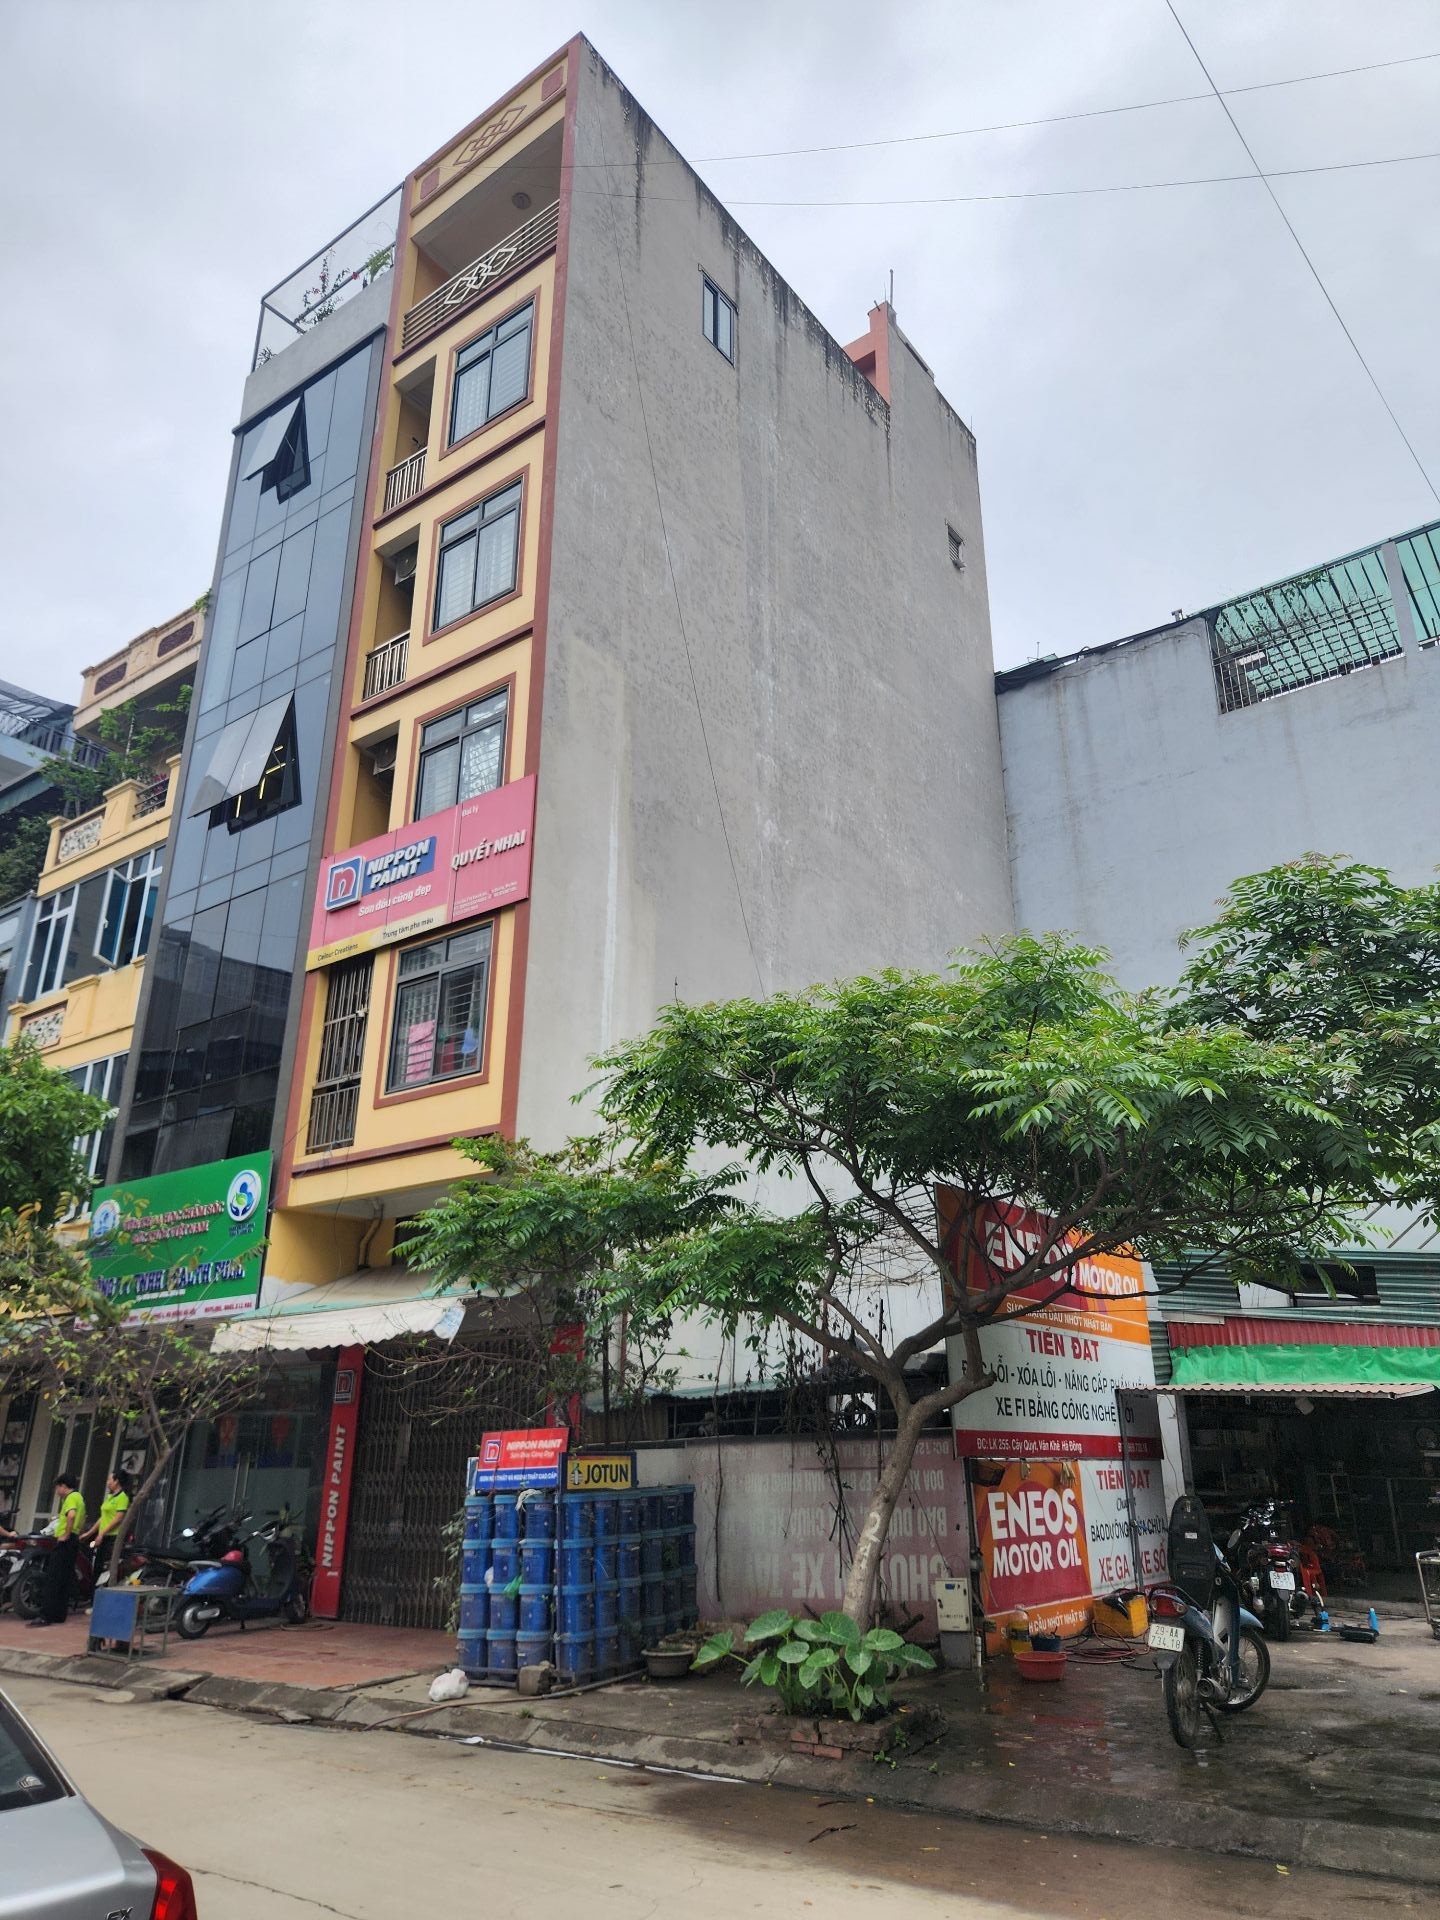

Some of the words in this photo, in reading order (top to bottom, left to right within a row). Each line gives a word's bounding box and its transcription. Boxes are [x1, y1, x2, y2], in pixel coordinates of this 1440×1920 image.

[367, 839, 431, 876] NIPPON
[451, 838, 493, 871] QUYẾT
[494, 829, 526, 855] NHAI
[370, 858, 421, 890] PAINT
[1079, 1261, 1122, 1295] MOTOR
[1070, 1337, 1099, 1363] ĐẠT
[1017, 1362, 1037, 1386] XÓA
[1041, 1361, 1056, 1388] LỖI
[1065, 1369, 1088, 1392] NÂNG
[1092, 1370, 1108, 1394] CẤP
[996, 1397, 1012, 1416] XE
[1015, 1398, 1025, 1417] FI
[1029, 1392, 1058, 1419] BẰNG
[1061, 1398, 1088, 1419] CÔNG
[1091, 1400, 1116, 1427] NGHỆ
[506, 1440, 537, 1451] NIPPON
[538, 1438, 563, 1449] PAINT
[585, 1464, 629, 1484] JOTUN
[322, 1490, 339, 1568] NIPPON
[332, 1424, 346, 1485] PAINT
[988, 1488, 1078, 1540] ENEOS
[1091, 1520, 1105, 1541] BẢO
[993, 1541, 1052, 1579] MOTOR
[1056, 1538, 1082, 1568] OIL
[1098, 1556, 1112, 1584] XE
[1115, 1553, 1131, 1581] GA
[1153, 1539, 1167, 1573] SỐ
